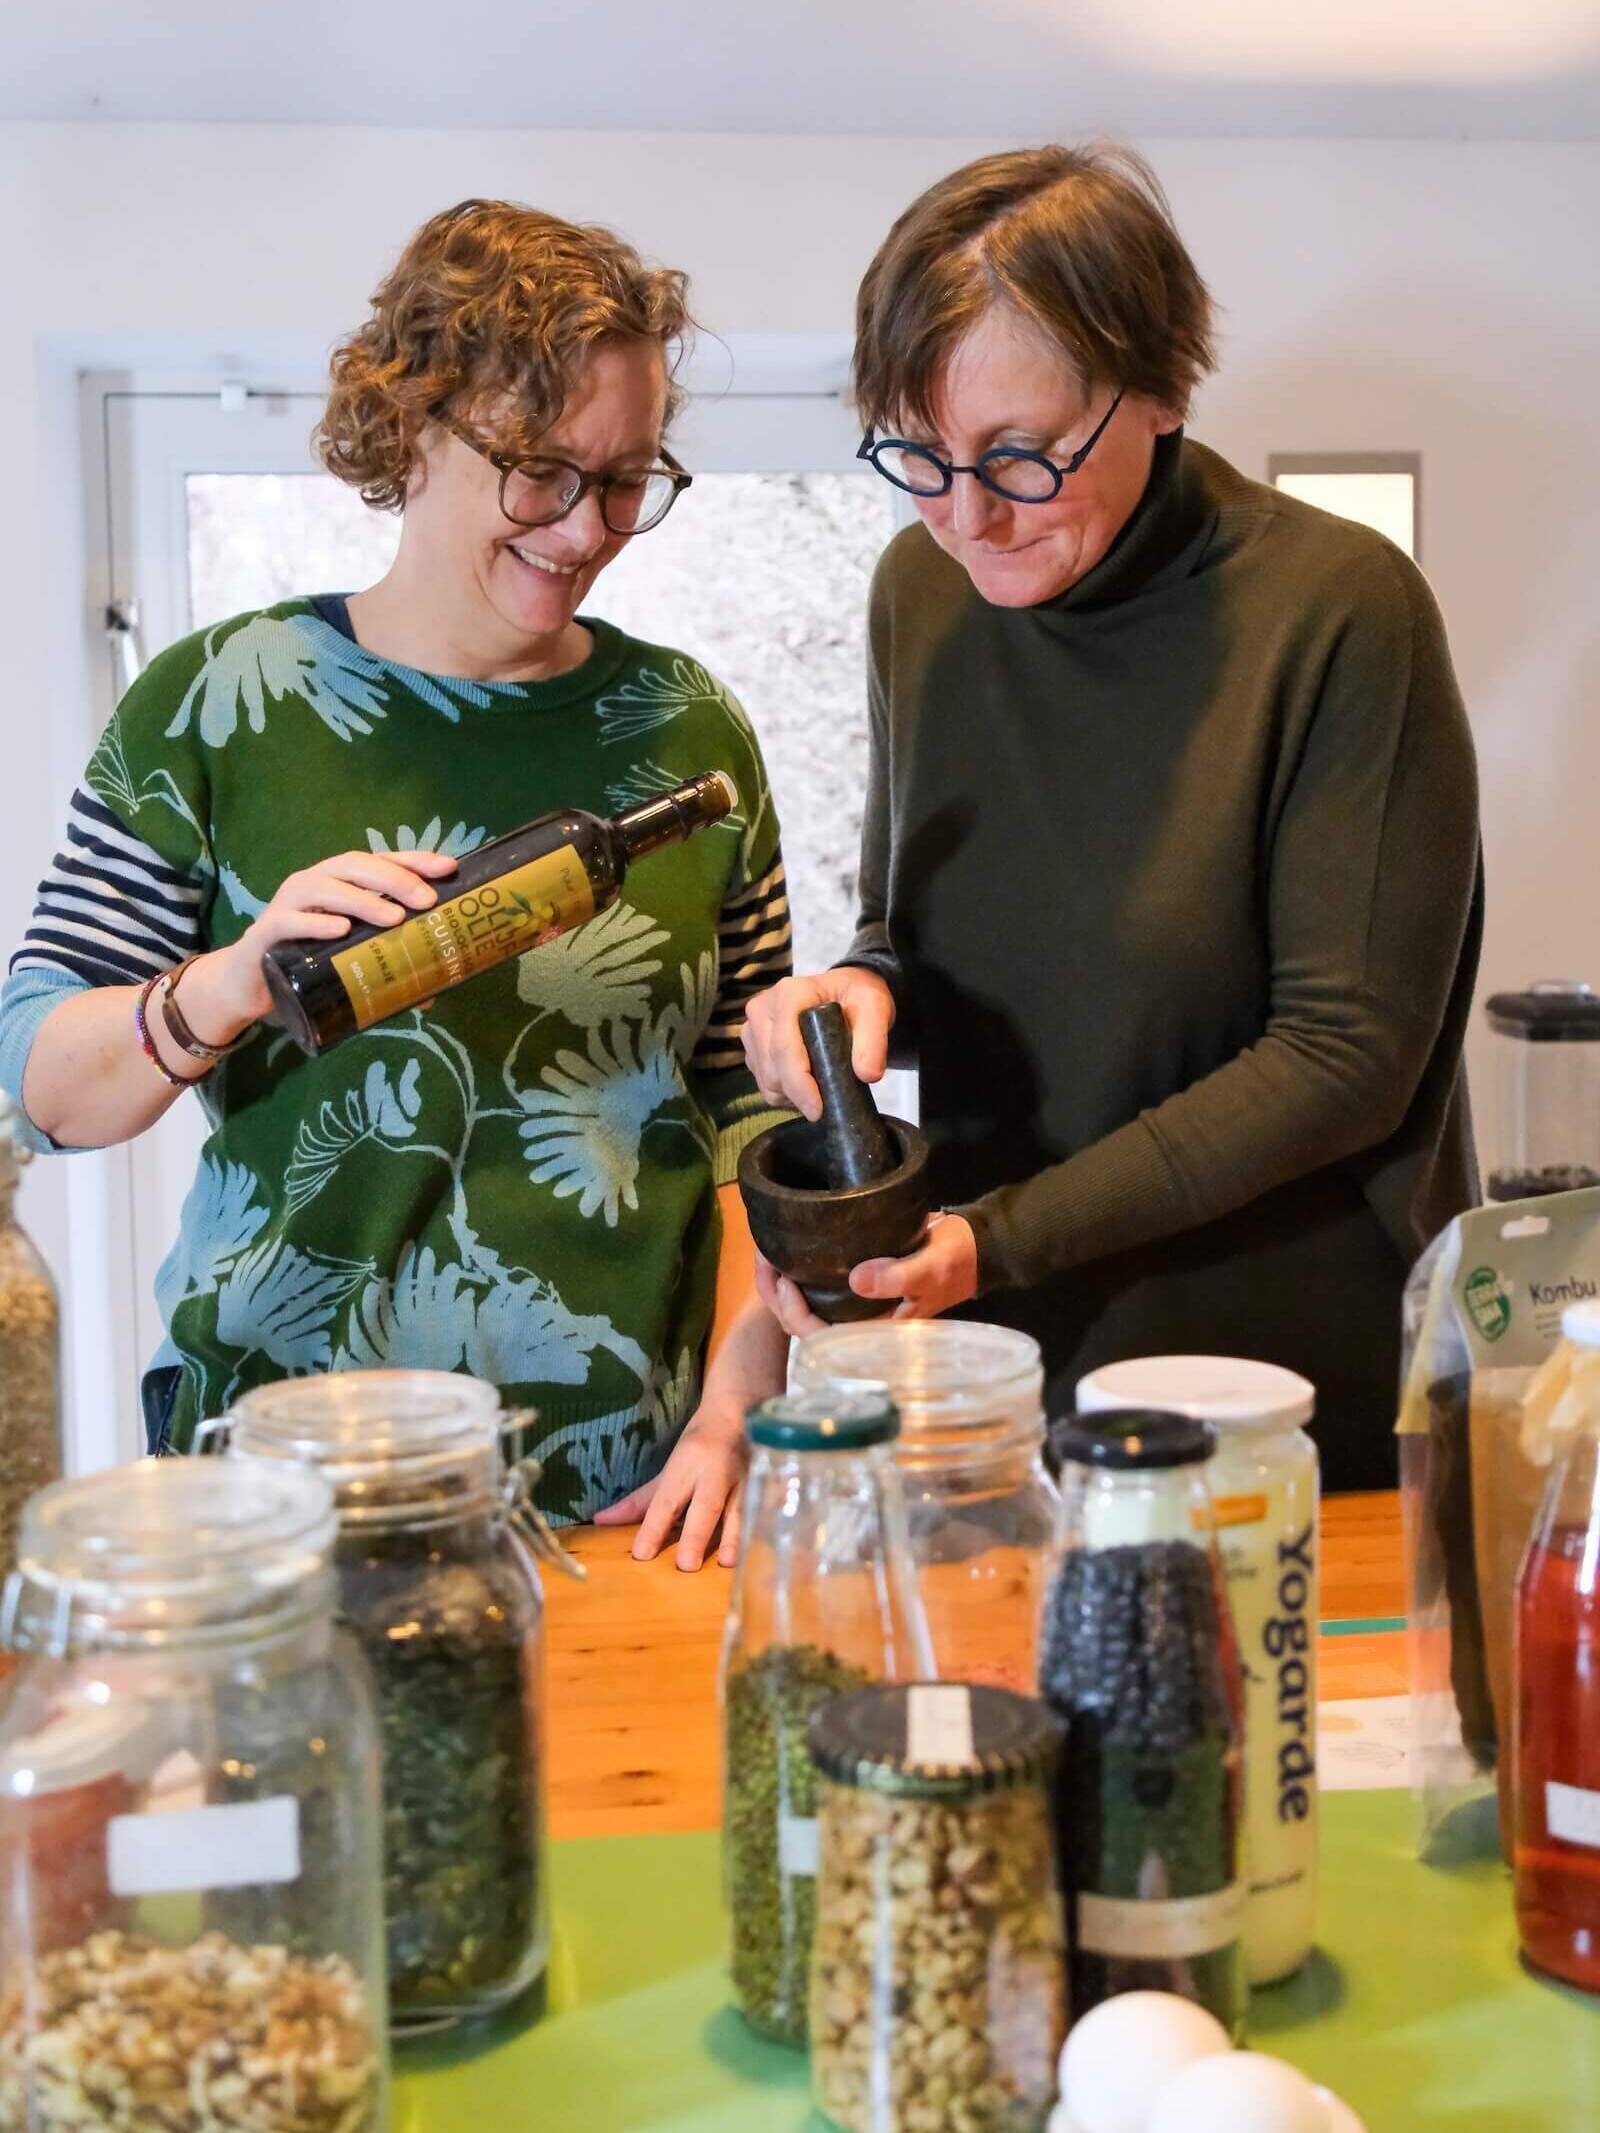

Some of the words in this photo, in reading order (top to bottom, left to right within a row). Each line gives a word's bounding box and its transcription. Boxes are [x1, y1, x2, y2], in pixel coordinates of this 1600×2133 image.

[427, 912, 463, 986] CUISINE
[459, 897, 495, 957] OLIE
[479, 887, 518, 958] OLIJF
[368, 942, 396, 985] SPANJE
[1529, 1275, 1596, 1305] Kombu
[1263, 1520, 1314, 1825] Yogarde
